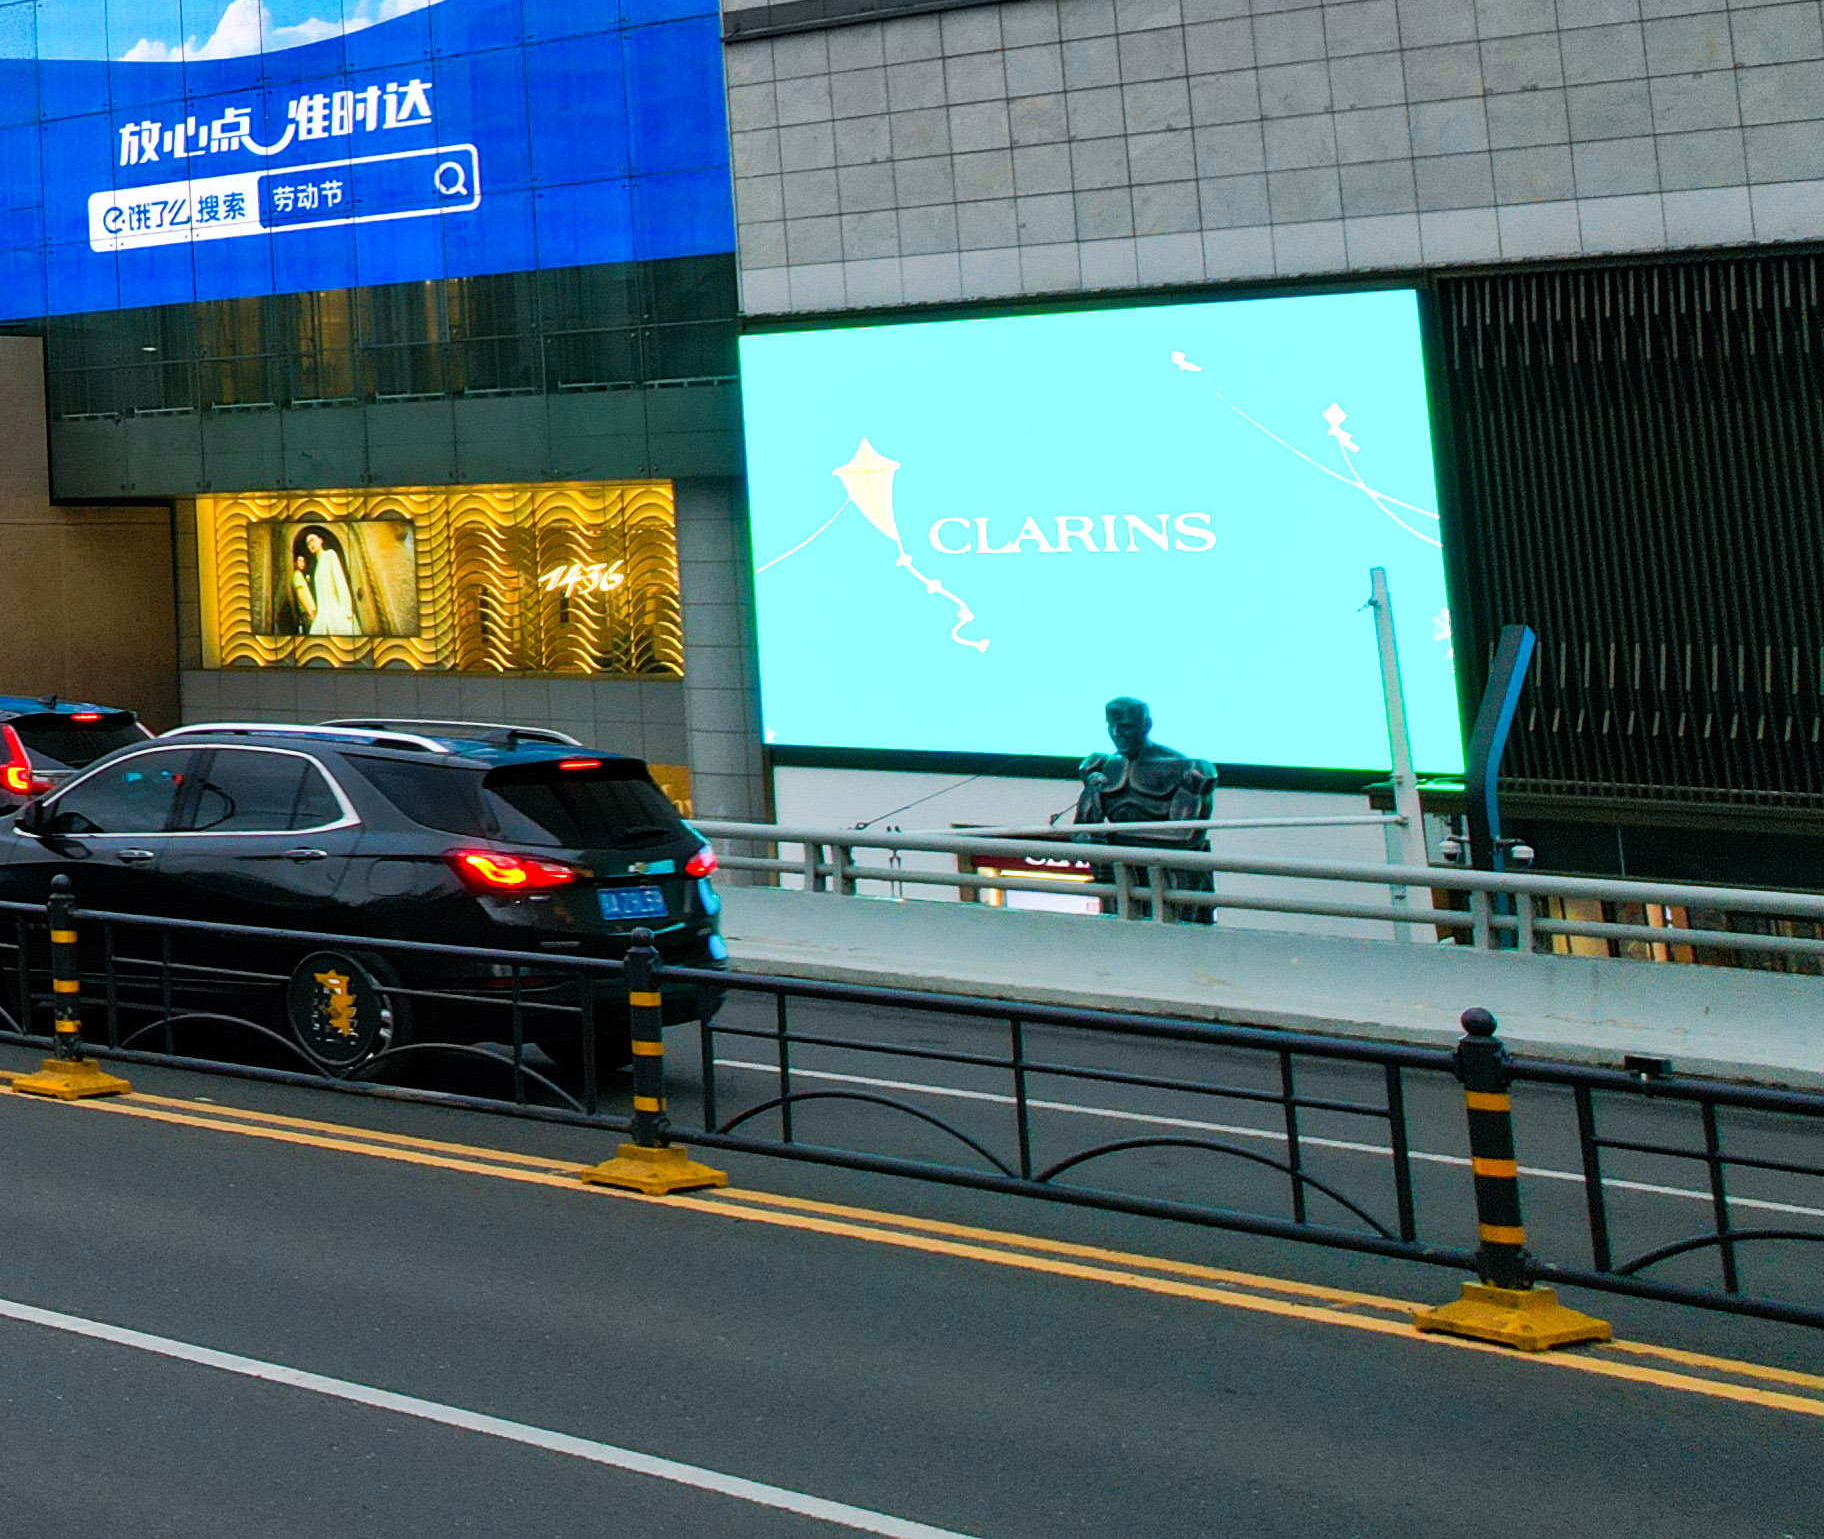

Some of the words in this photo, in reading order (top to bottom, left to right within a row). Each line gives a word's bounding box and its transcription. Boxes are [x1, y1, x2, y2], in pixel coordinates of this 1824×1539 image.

[273, 180, 345, 212] 劳动节
[928, 512, 1217, 555] CLARINS
